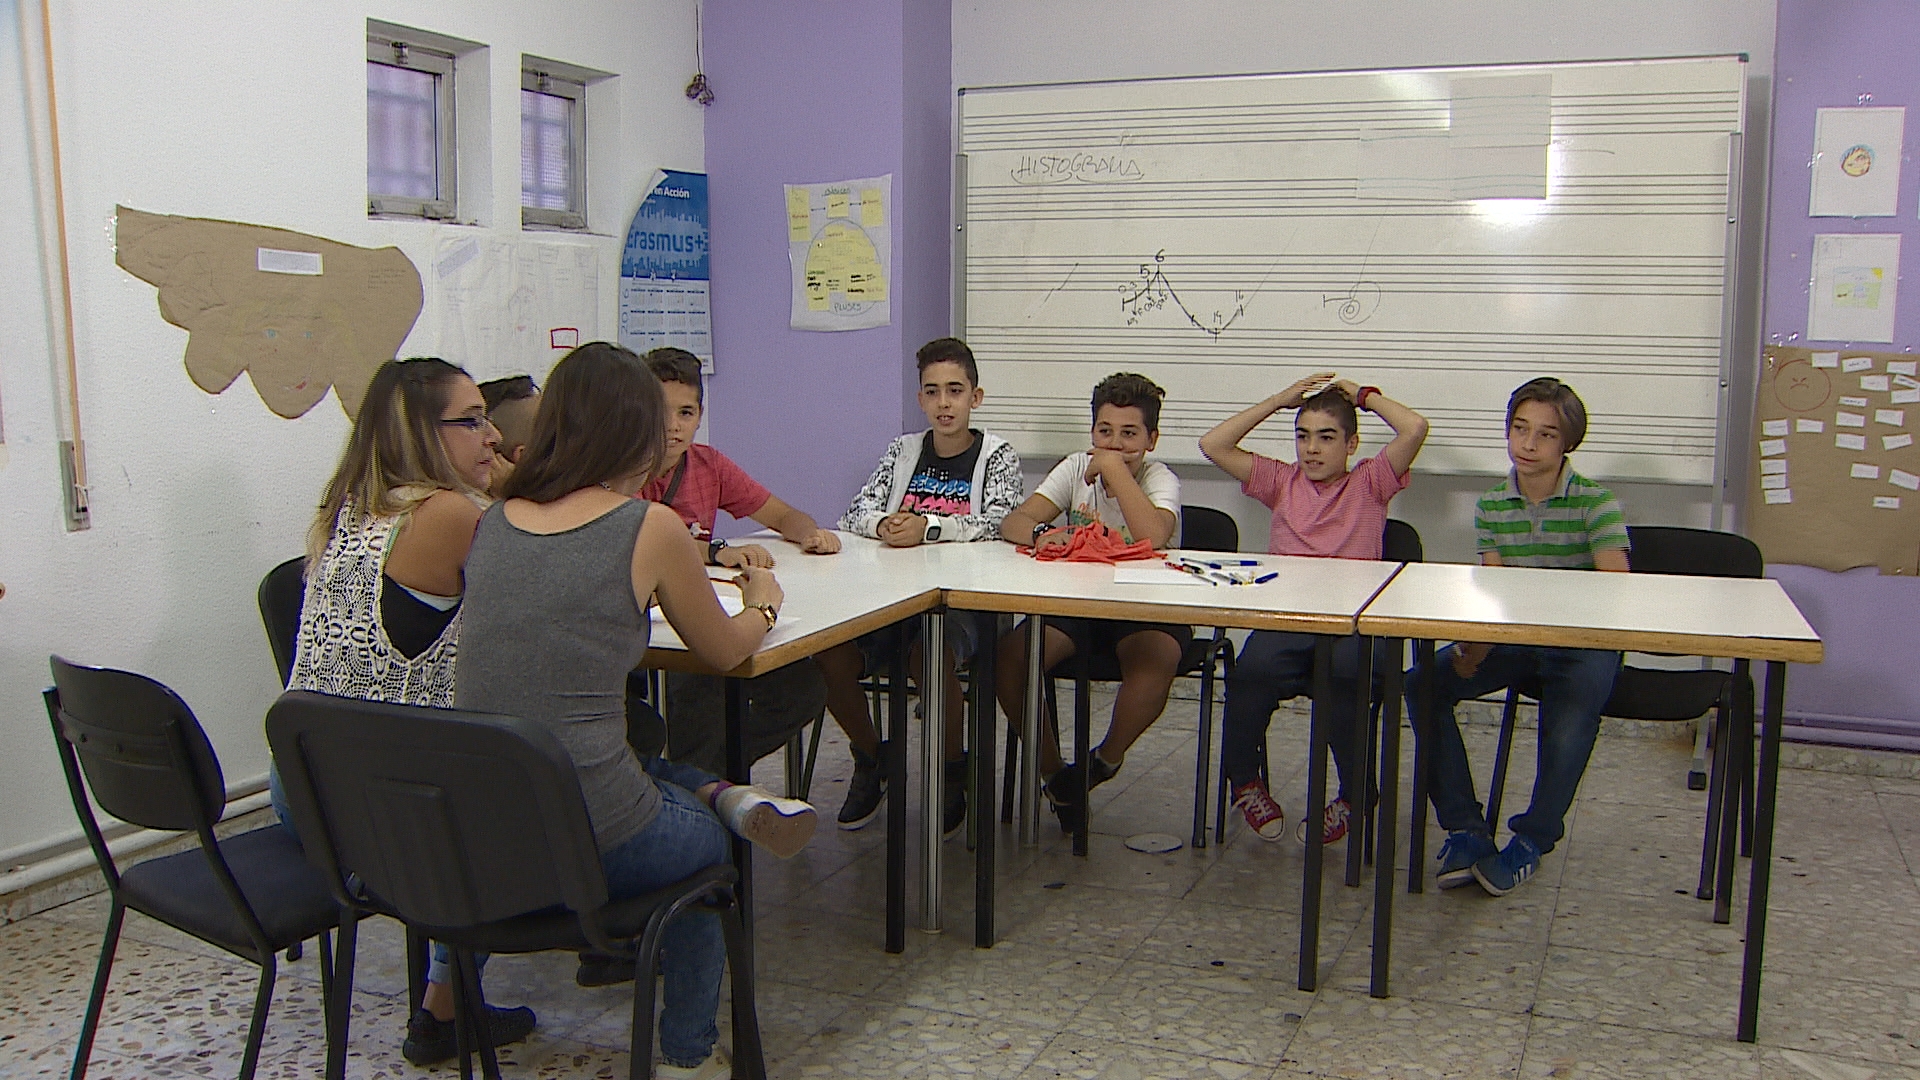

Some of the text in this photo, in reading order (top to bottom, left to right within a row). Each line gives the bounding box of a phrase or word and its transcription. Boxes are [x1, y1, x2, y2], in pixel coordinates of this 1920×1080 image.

[664, 186, 690, 199] Acción
[1154, 249, 1165, 263] 6
[1139, 264, 1150, 279] 5
